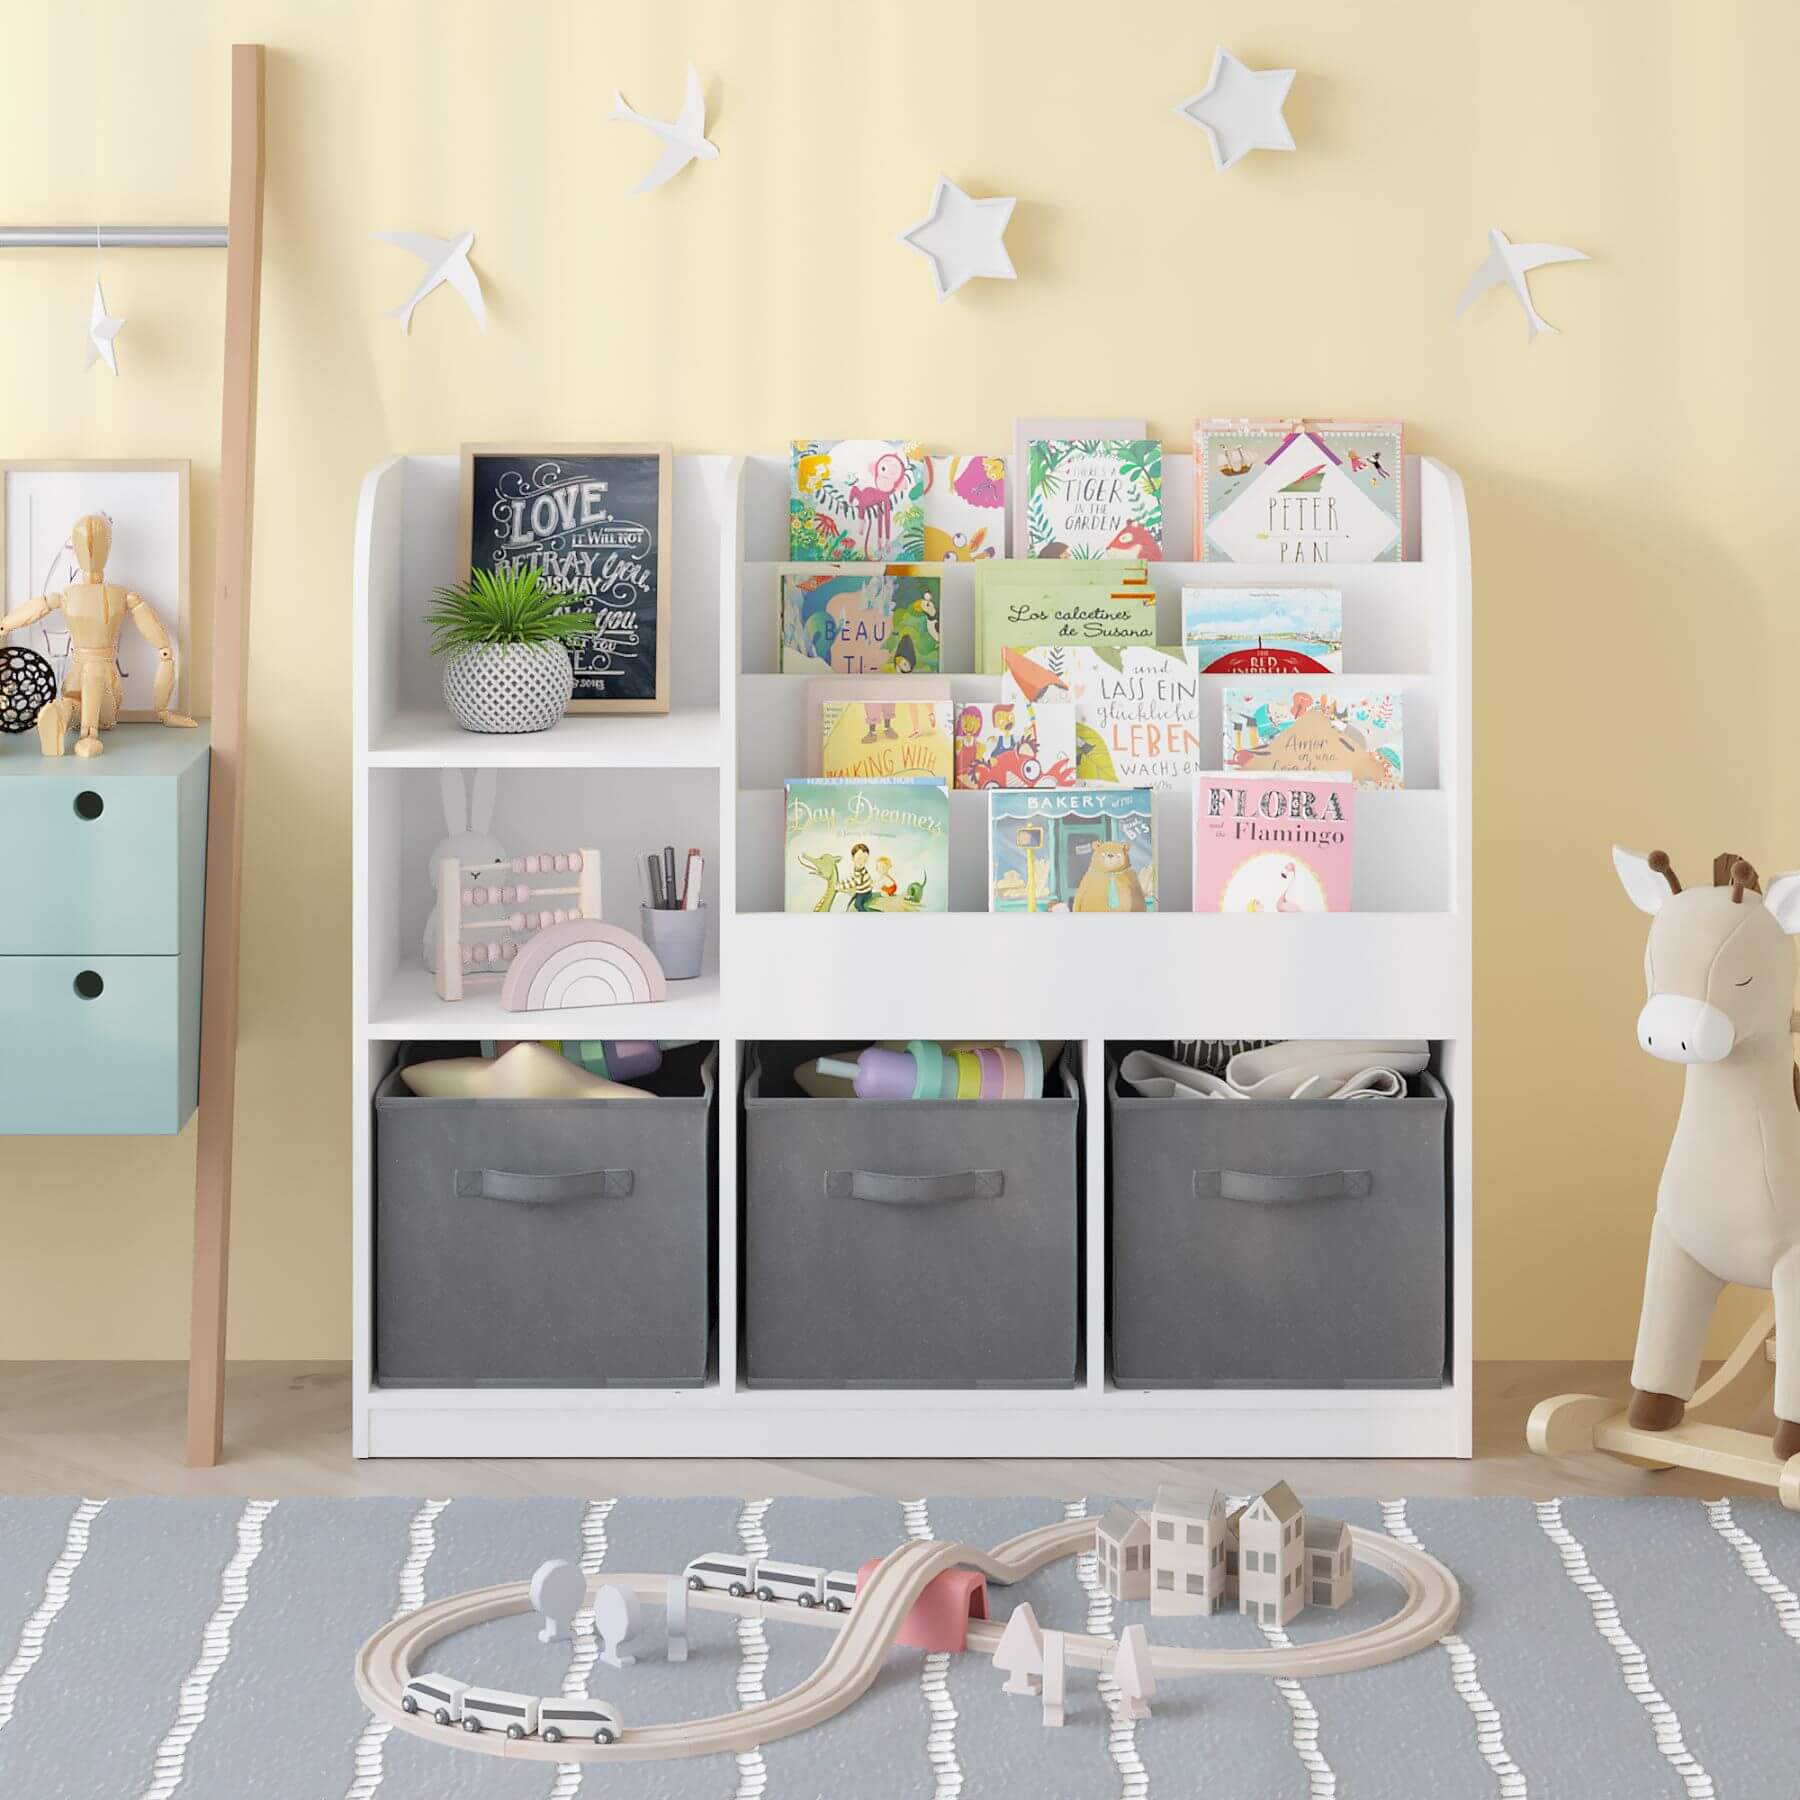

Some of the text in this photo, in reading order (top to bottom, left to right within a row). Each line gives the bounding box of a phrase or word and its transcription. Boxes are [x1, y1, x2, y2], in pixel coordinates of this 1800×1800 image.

[1062, 478, 1122, 503] TIGER
[1064, 515, 1122, 531] GARDEN
[1268, 496, 1339, 531] PETER
[616, 532, 643, 545] NOT
[1280, 541, 1329, 563] PAN
[1007, 604, 1132, 623] Los calcetines
[825, 619, 899, 642] BEAU-
[1058, 622, 1153, 638] de Susana
[842, 655, 878, 674] TI-
[1134, 659, 1169, 674] und
[1250, 656, 1278, 667] RED
[1101, 676, 1197, 702] LASS EIN
[1112, 722, 1200, 758] LEBEN
[901, 745, 937, 771] WITH
[787, 791, 943, 834] Day Dreamers
[1027, 795, 1107, 809] BAKERY
[1204, 787, 1349, 822] FLORA
[1235, 821, 1345, 849] Flamingo
